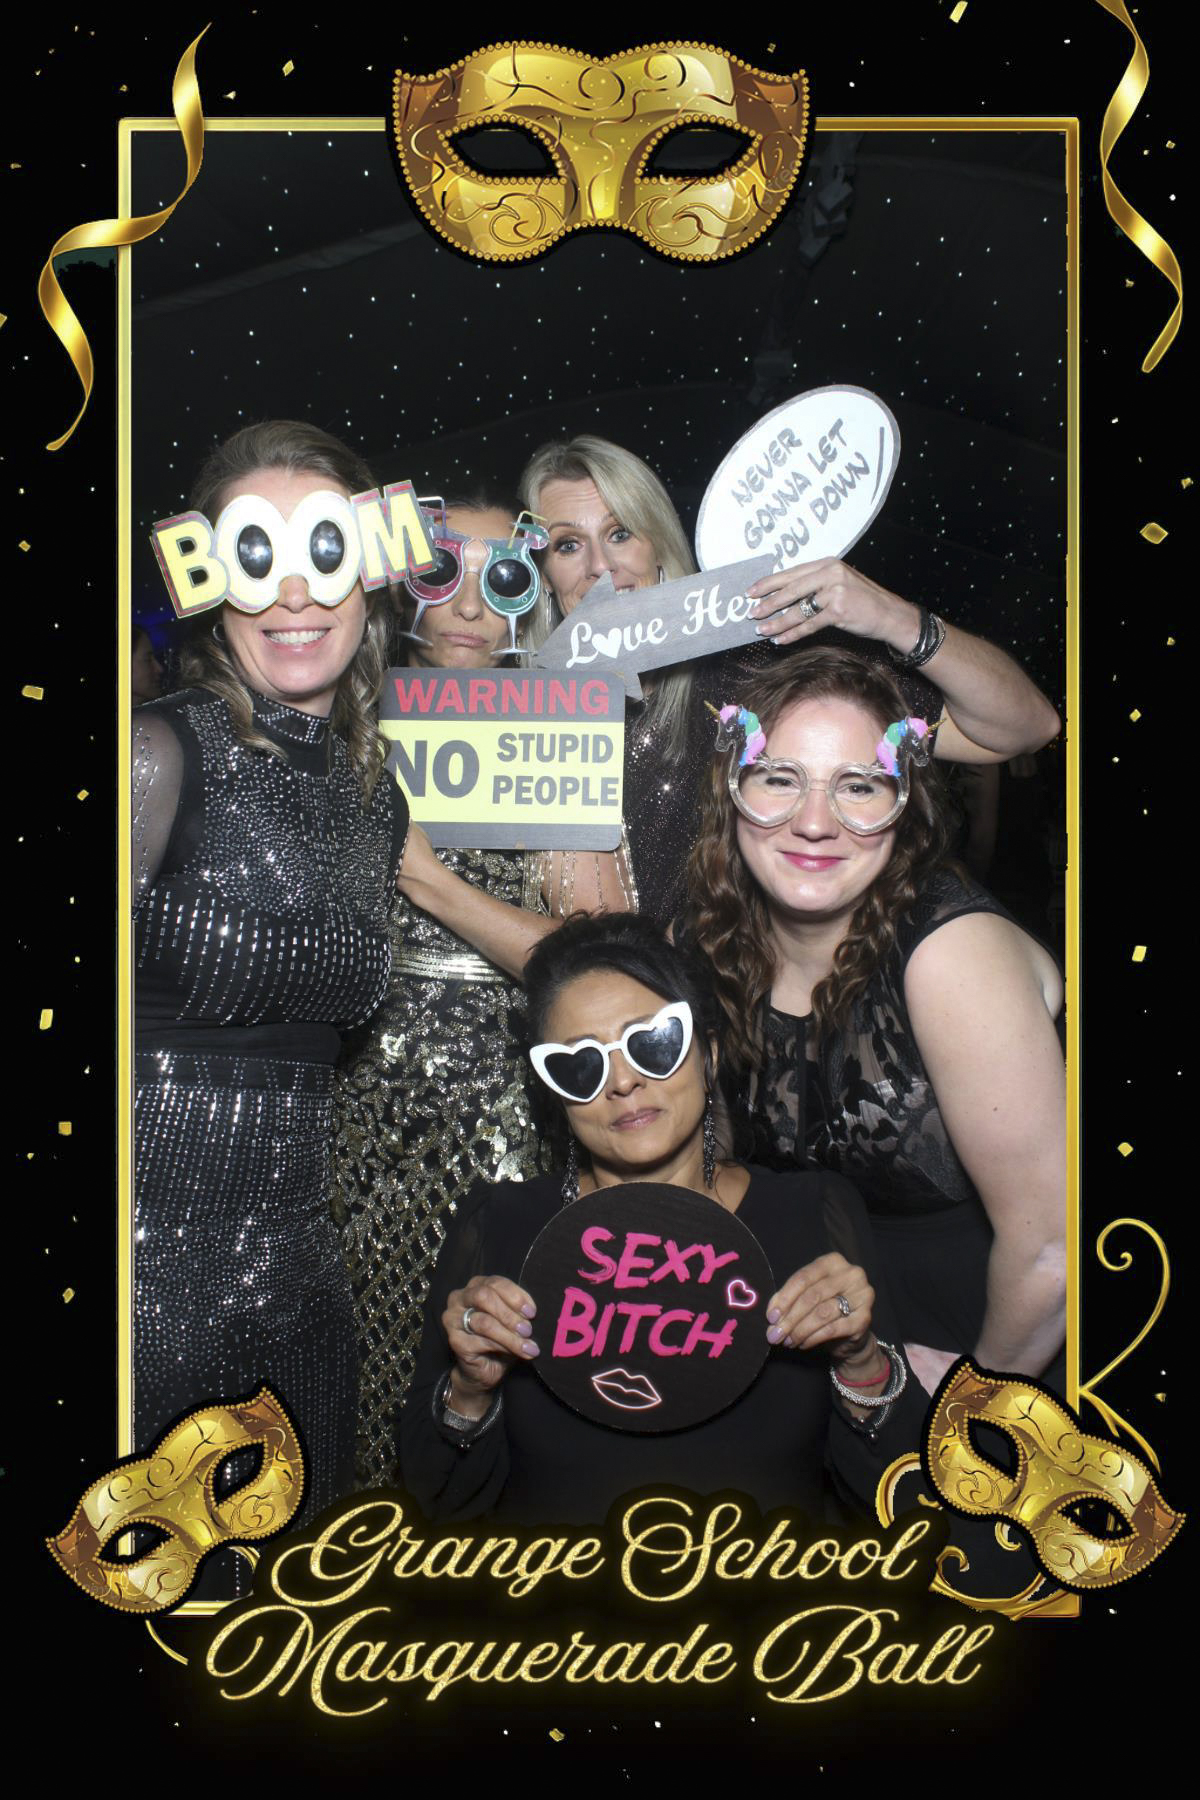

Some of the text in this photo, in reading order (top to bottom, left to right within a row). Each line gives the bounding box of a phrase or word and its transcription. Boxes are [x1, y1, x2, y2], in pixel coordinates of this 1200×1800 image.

[731, 428, 802, 507] NEVER
[744, 418, 847, 549] GONNA LET
[809, 451, 870, 525] DOWN
[150, 480, 437, 618] BOOM
[394, 678, 609, 716] WARNING
[384, 739, 480, 799] NO
[496, 732, 614, 763] STUPID
[491, 774, 619, 807] PEOPLE
[577, 1226, 740, 1289] SEXY
[552, 1286, 738, 1358] BITCH
